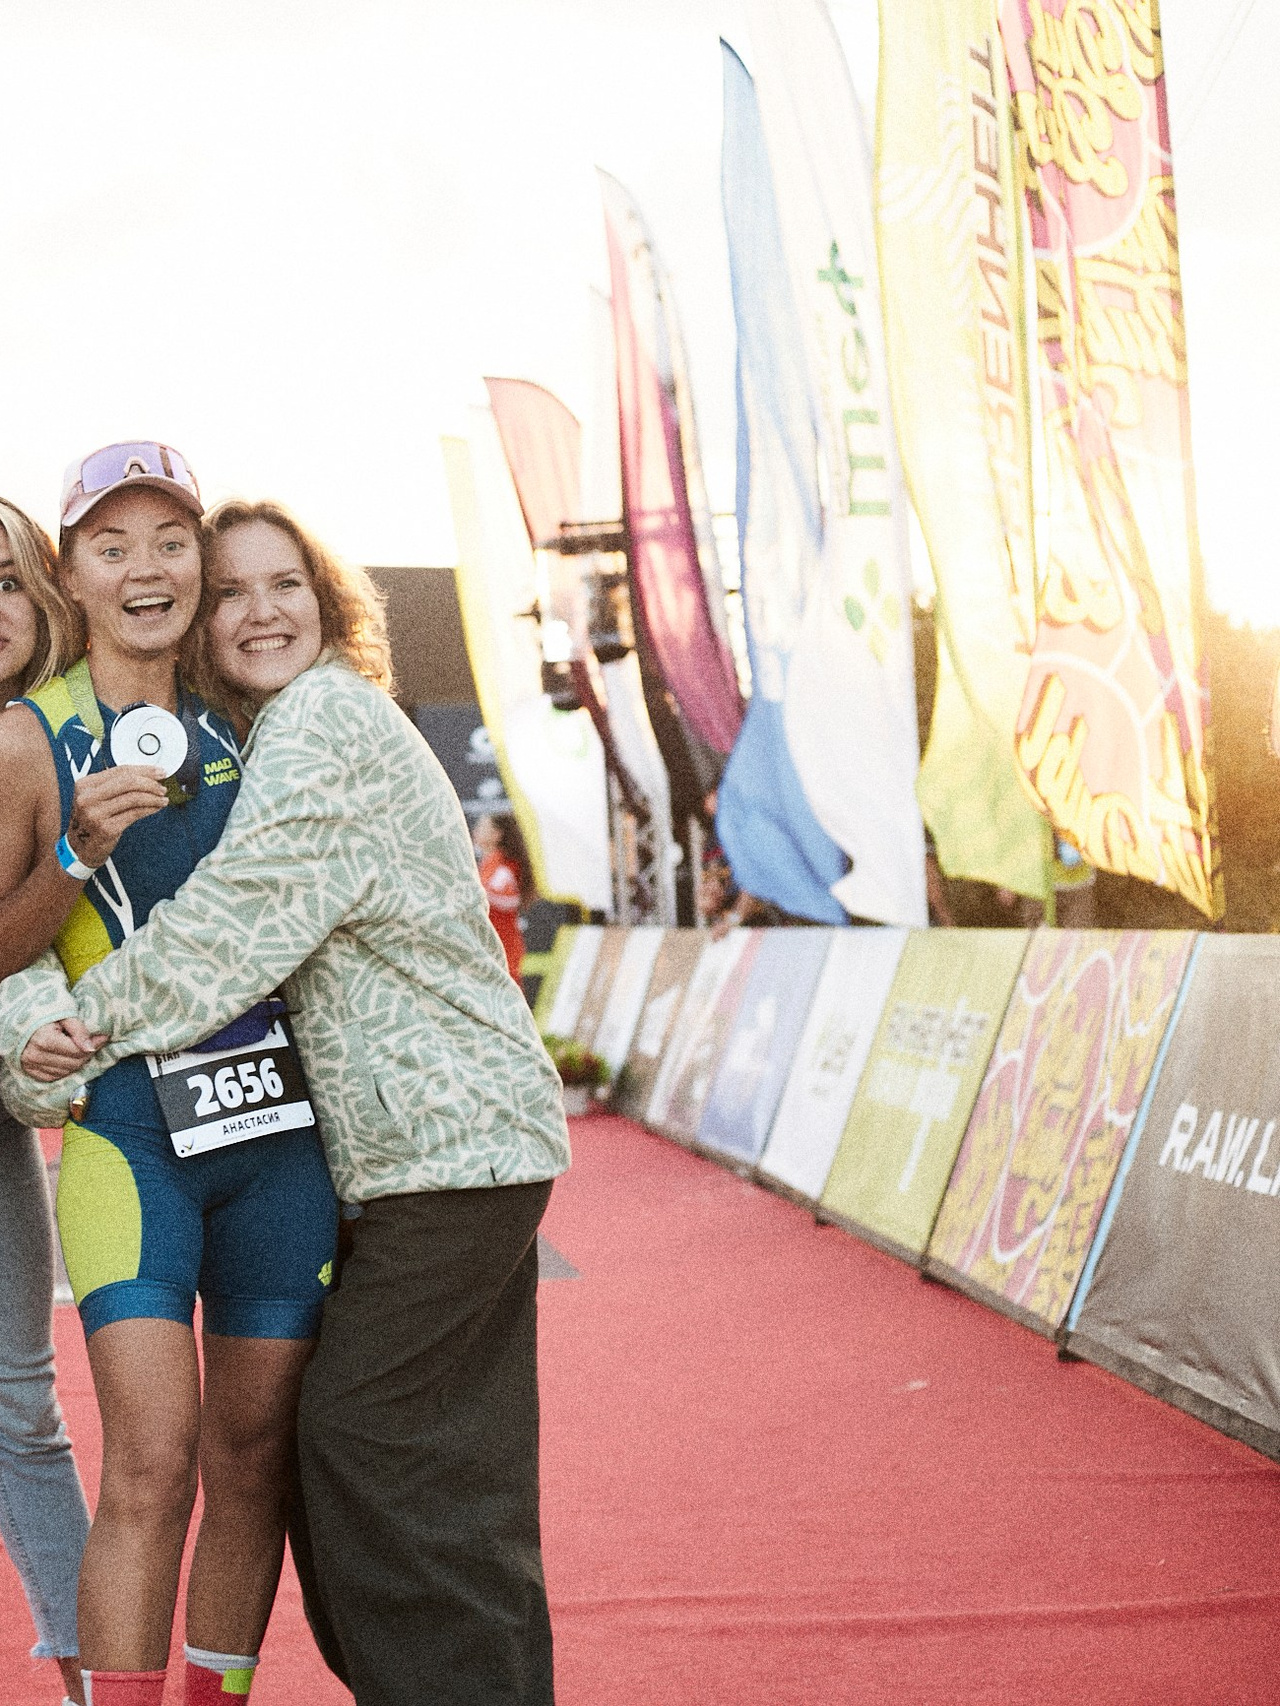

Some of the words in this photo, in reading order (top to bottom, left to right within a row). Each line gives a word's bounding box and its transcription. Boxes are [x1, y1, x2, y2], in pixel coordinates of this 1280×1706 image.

[204, 757, 232, 775] MAD
[203, 769, 240, 787] WAVE
[186, 1057, 284, 1118] 2656
[222, 1111, 281, 1136] АНАСТАСИЯ
